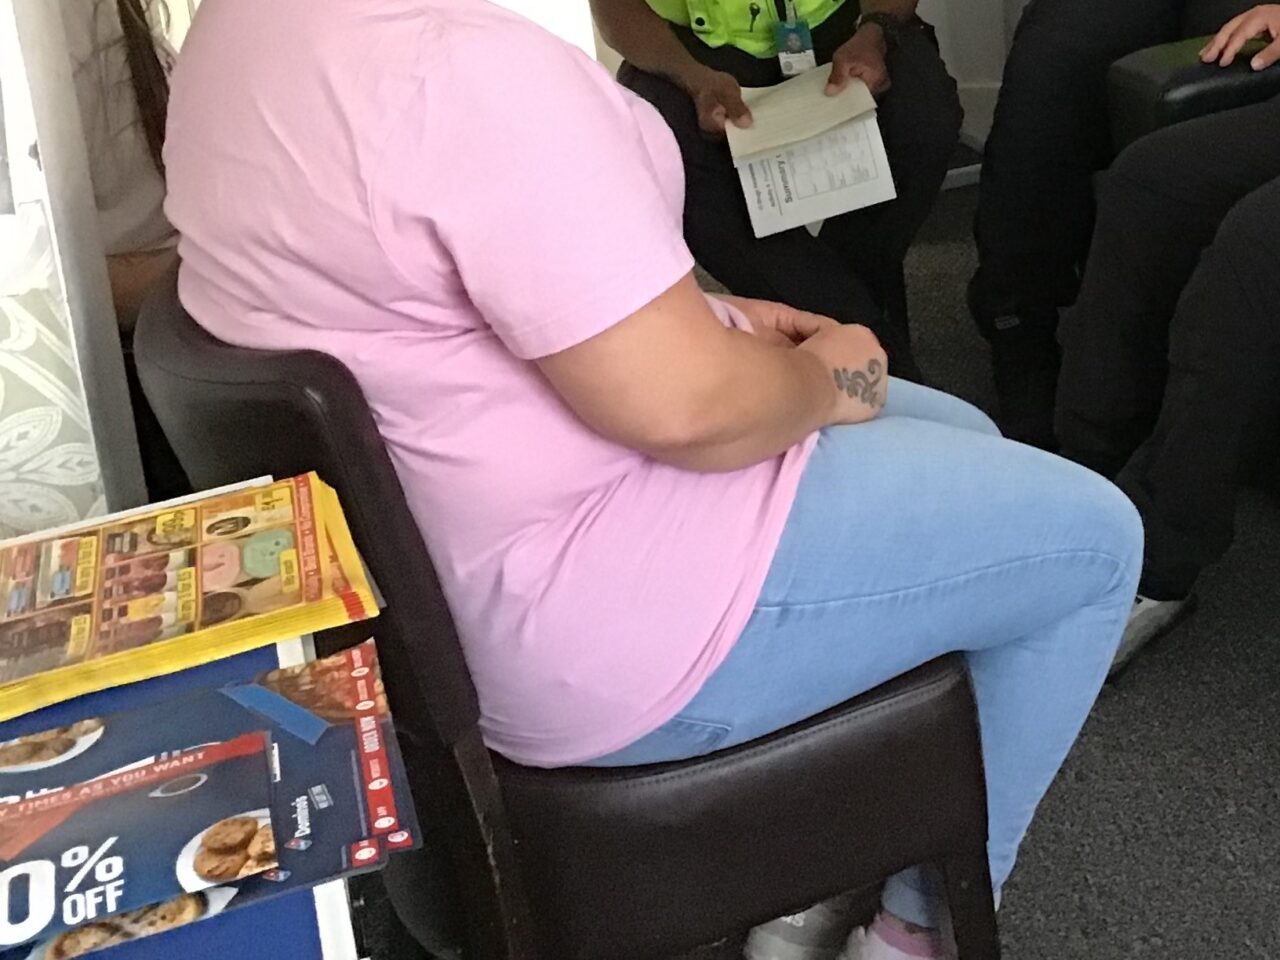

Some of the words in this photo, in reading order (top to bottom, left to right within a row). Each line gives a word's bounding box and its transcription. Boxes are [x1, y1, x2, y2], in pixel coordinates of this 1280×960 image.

[18, 791, 73, 813] TIMES
[110, 769, 147, 786] YOU
[153, 750, 208, 774] WANT
[62, 878, 125, 926] OFF
